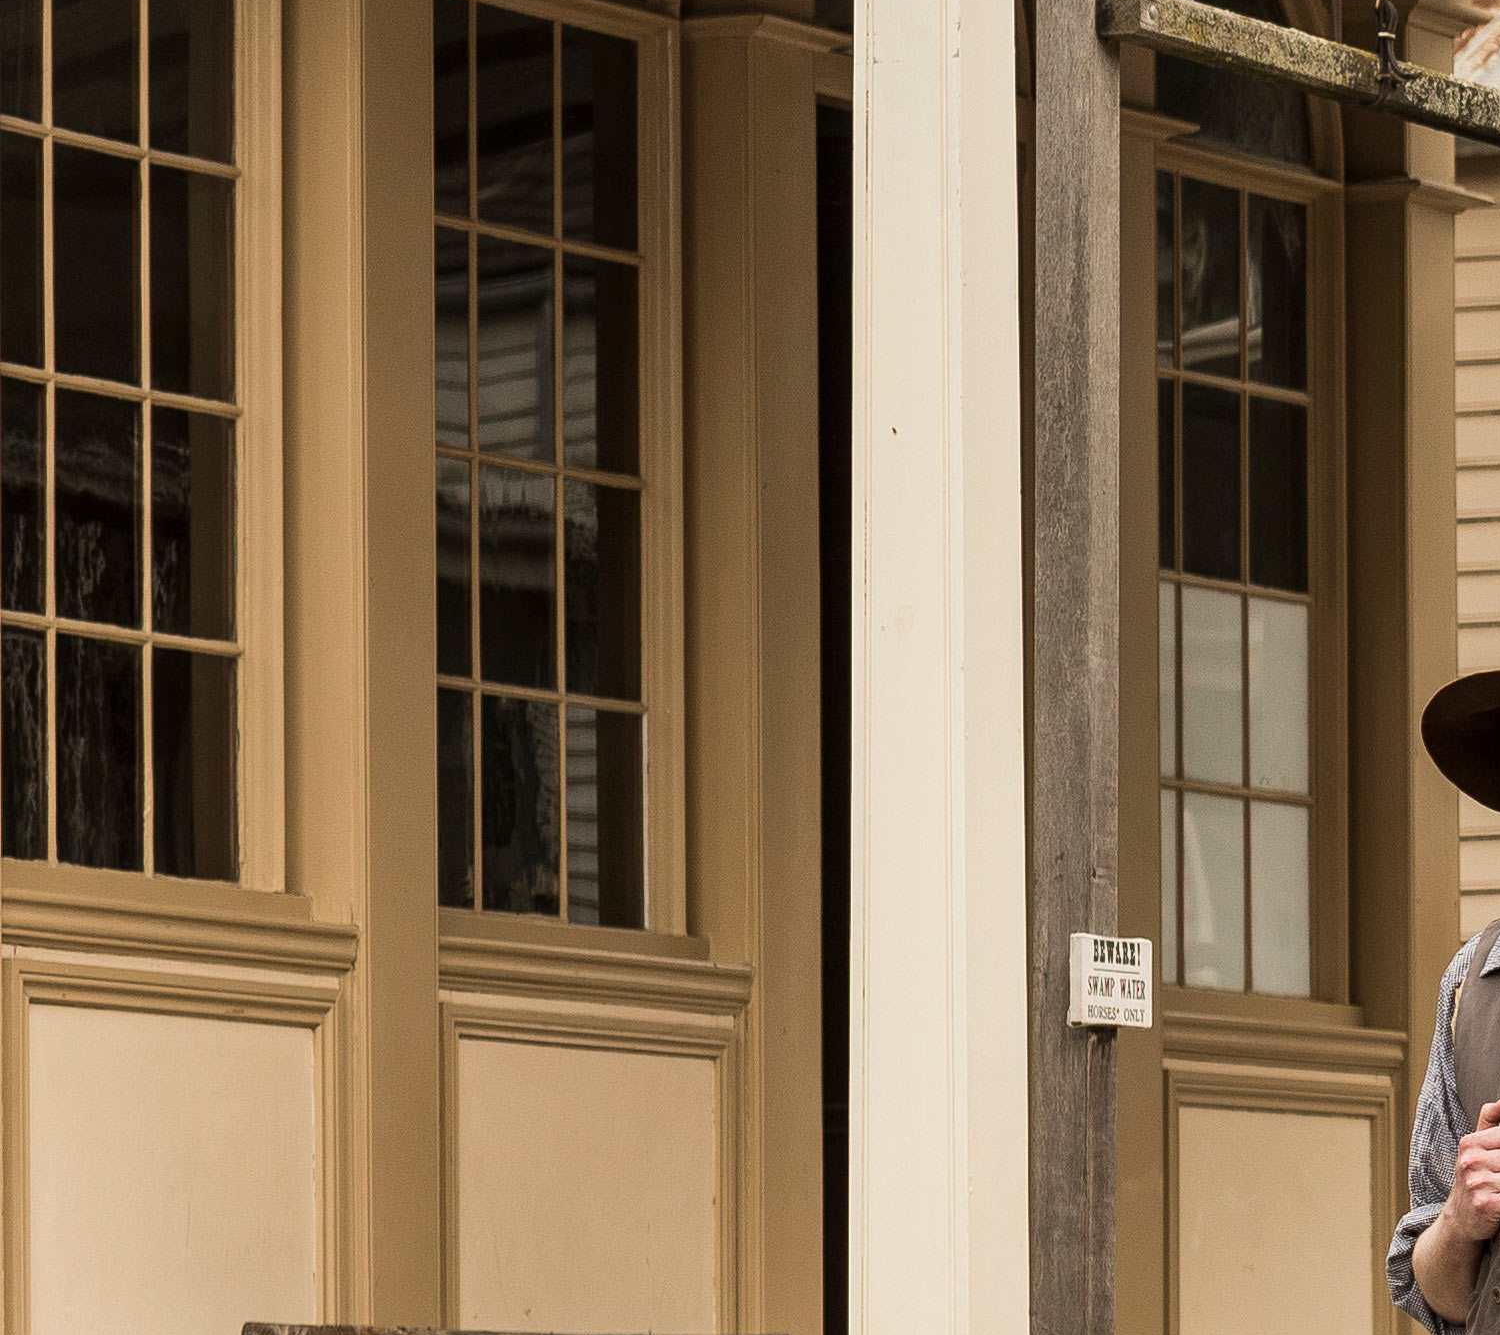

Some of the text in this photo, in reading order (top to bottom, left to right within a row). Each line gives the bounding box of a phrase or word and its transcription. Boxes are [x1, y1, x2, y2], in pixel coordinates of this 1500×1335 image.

[1093, 939, 1141, 967] BEWARE!
[1087, 976, 1146, 1001] SWAMP WATER
[1124, 1008, 1145, 1023] ONLY
